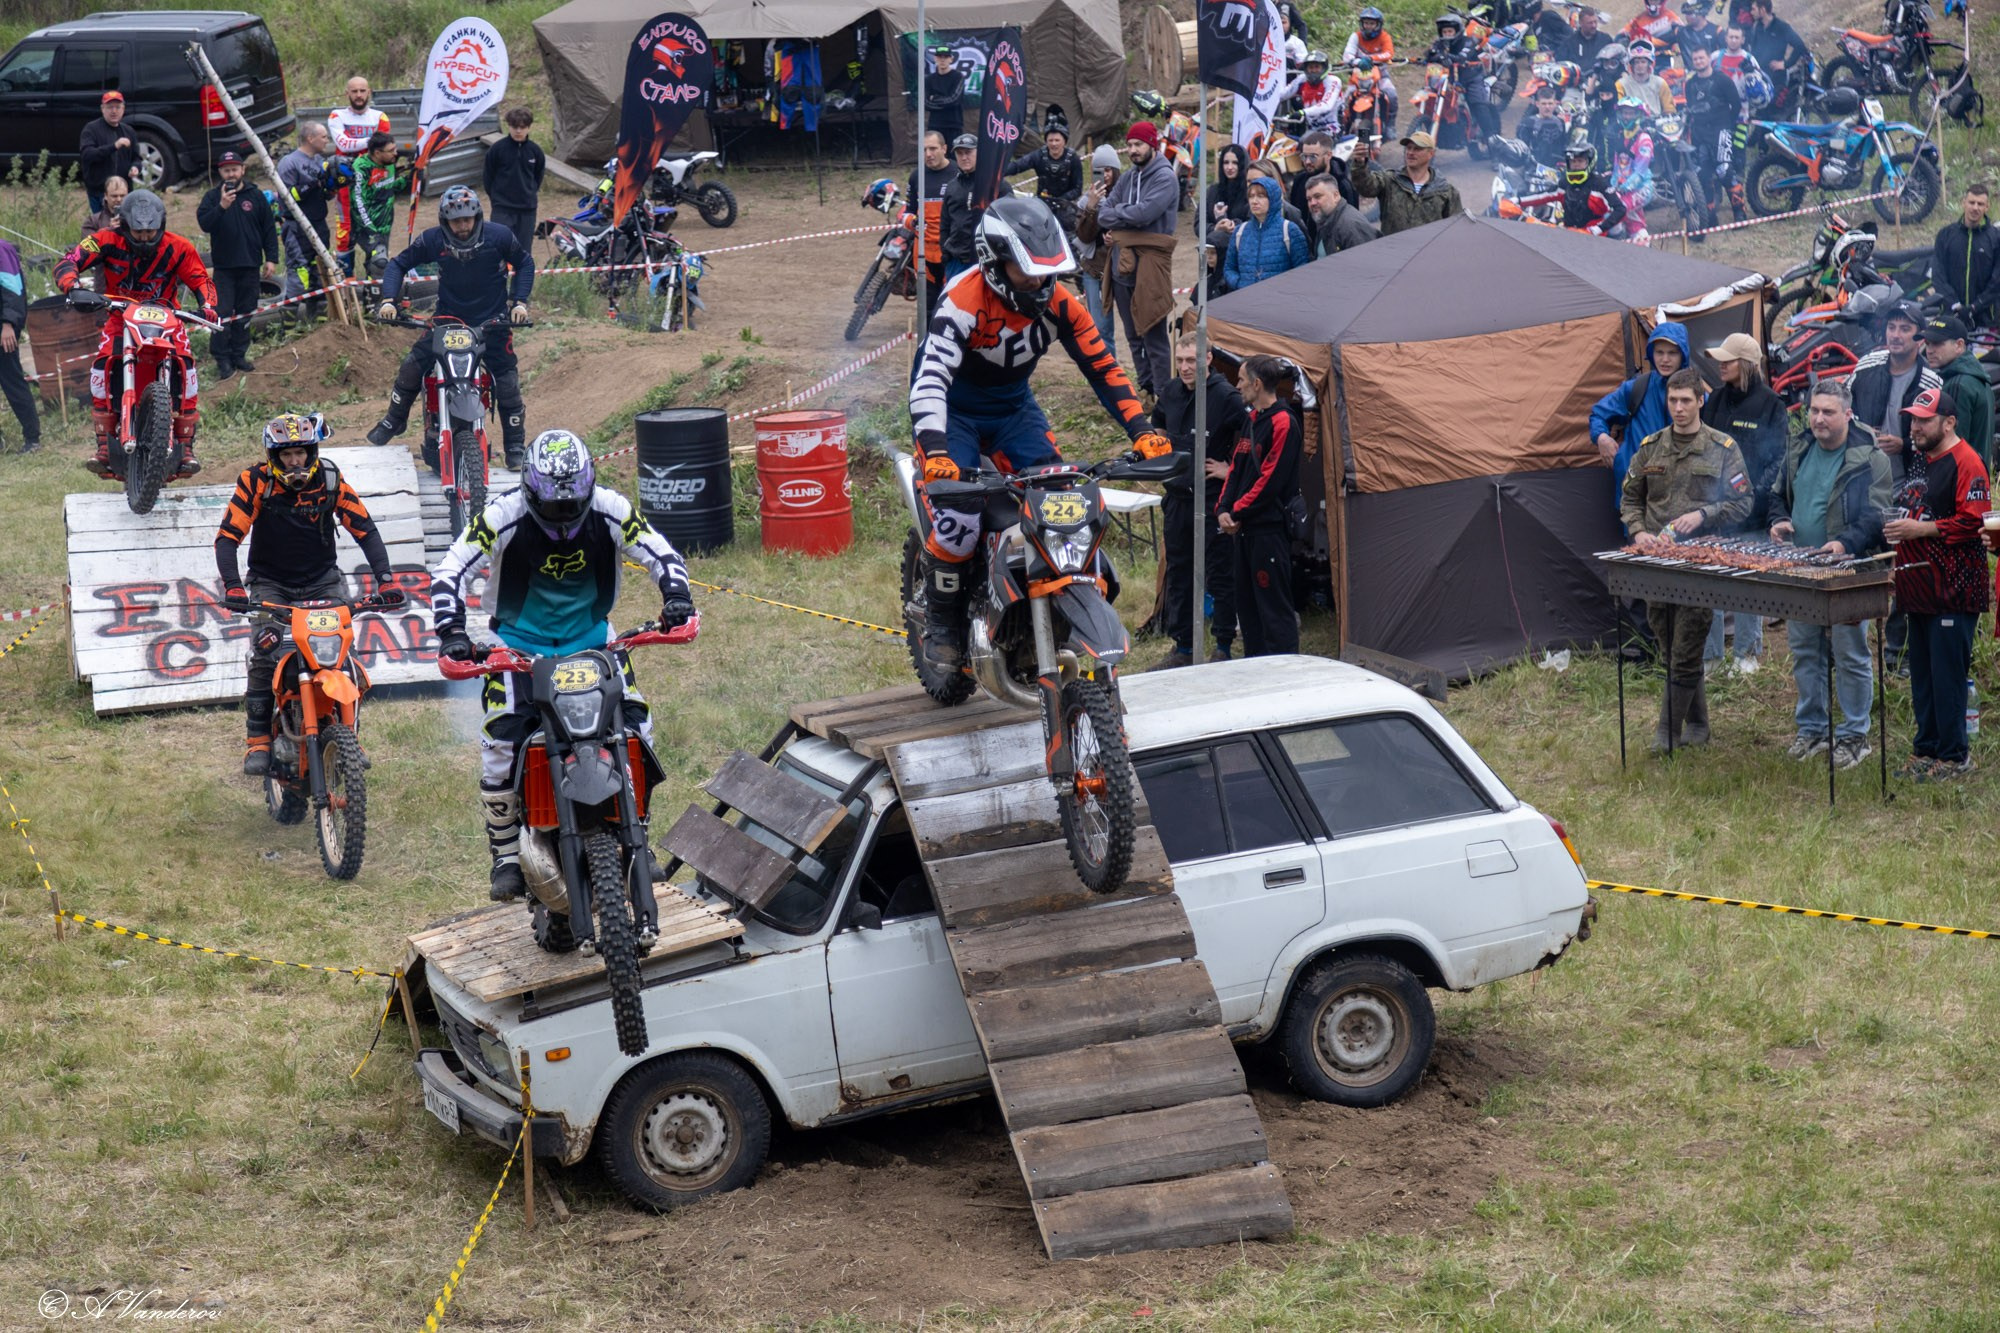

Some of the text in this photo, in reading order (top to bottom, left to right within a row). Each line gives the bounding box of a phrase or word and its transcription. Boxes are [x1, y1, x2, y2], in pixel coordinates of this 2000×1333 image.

[443, 27, 496, 52] СТАНКИ ЧПУ
[638, 21, 706, 54] ENDURO
[989, 41, 1024, 86] ENDURO
[1261, 52, 1282, 69] RCUT
[434, 60, 500, 81] HYPERCUT
[147, 311, 158, 319] 17
[451, 336, 464, 345] 50
[926, 467, 957, 480] FOX
[638, 477, 706, 493] ECORD
[640, 491, 695, 503] ANCE RADIO
[779, 486, 822, 498] SINTEC
[1053, 503, 1075, 517] 24
[319, 617, 327, 626] 8
[1098, 649, 1125, 657] CHAMP
[565, 671, 586, 684] 23
[1038, 687, 1050, 740] CHAMP
